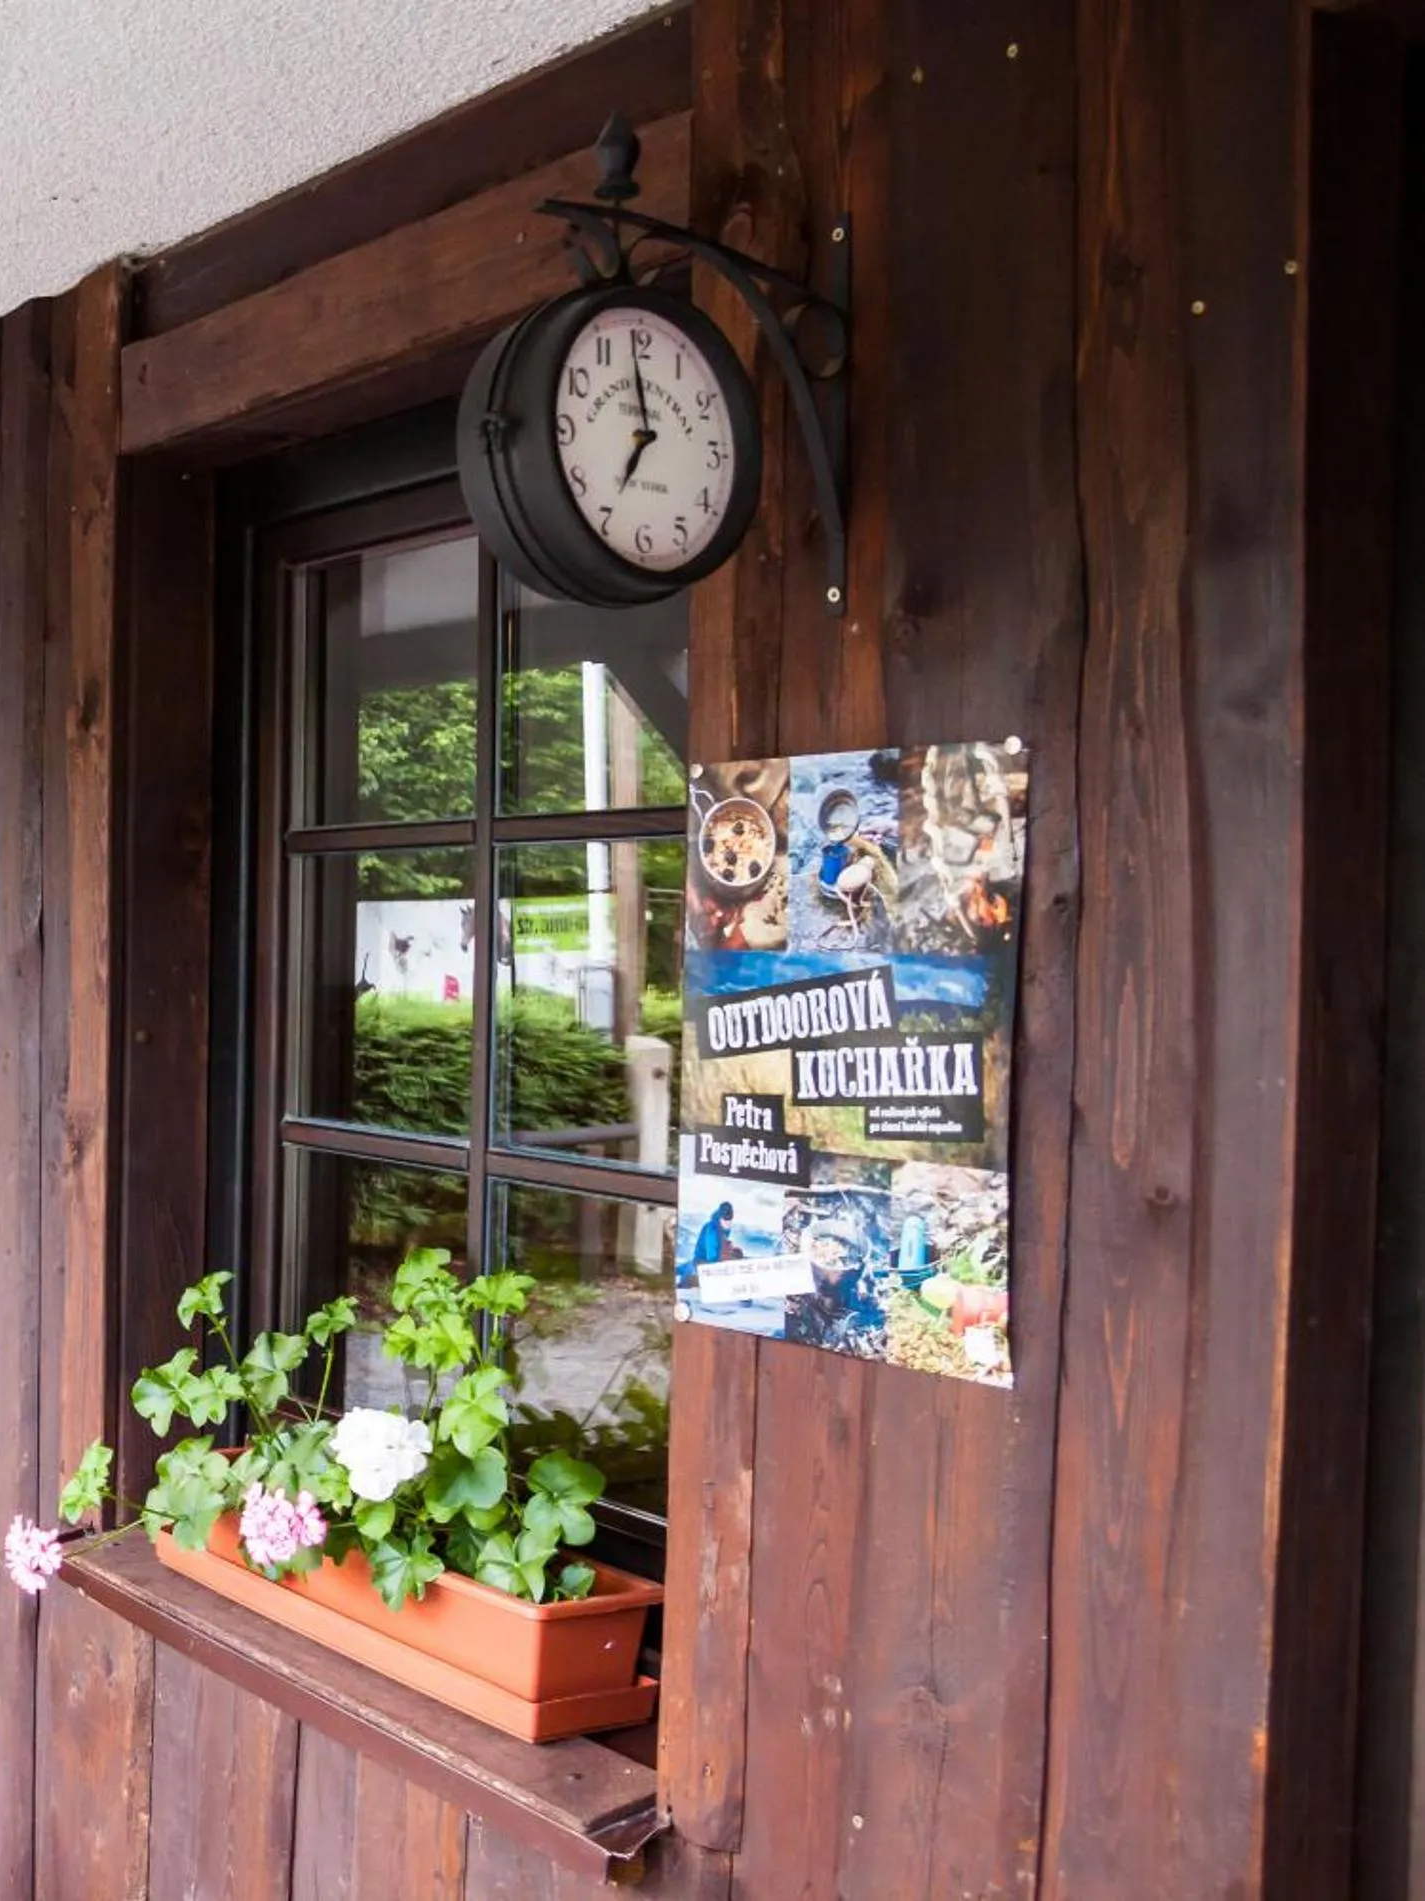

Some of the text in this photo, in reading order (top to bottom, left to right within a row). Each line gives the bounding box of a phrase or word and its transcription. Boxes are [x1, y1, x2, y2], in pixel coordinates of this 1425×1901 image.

[596, 336, 612, 367] 11
[629, 328, 652, 360] 2
[567, 366, 591, 399] 10
[675, 352, 682, 381] 1
[635, 378, 693, 441] ENTRAL
[695, 390, 711, 421] 2
[556, 413, 575, 446] 9
[706, 440, 721, 470] 3
[569, 465, 587, 498] 8
[694, 486, 712, 514] 4
[598, 506, 613, 537] 7
[672, 516, 688, 546] 5
[635, 525, 653, 554] 6
[707, 973, 893, 1051] OUTDOOROVÁ
[795, 1036, 978, 1099] KUCHAŘKA
[724, 1096, 773, 1131] Petra
[700, 1133, 799, 1175] Pospěchová
